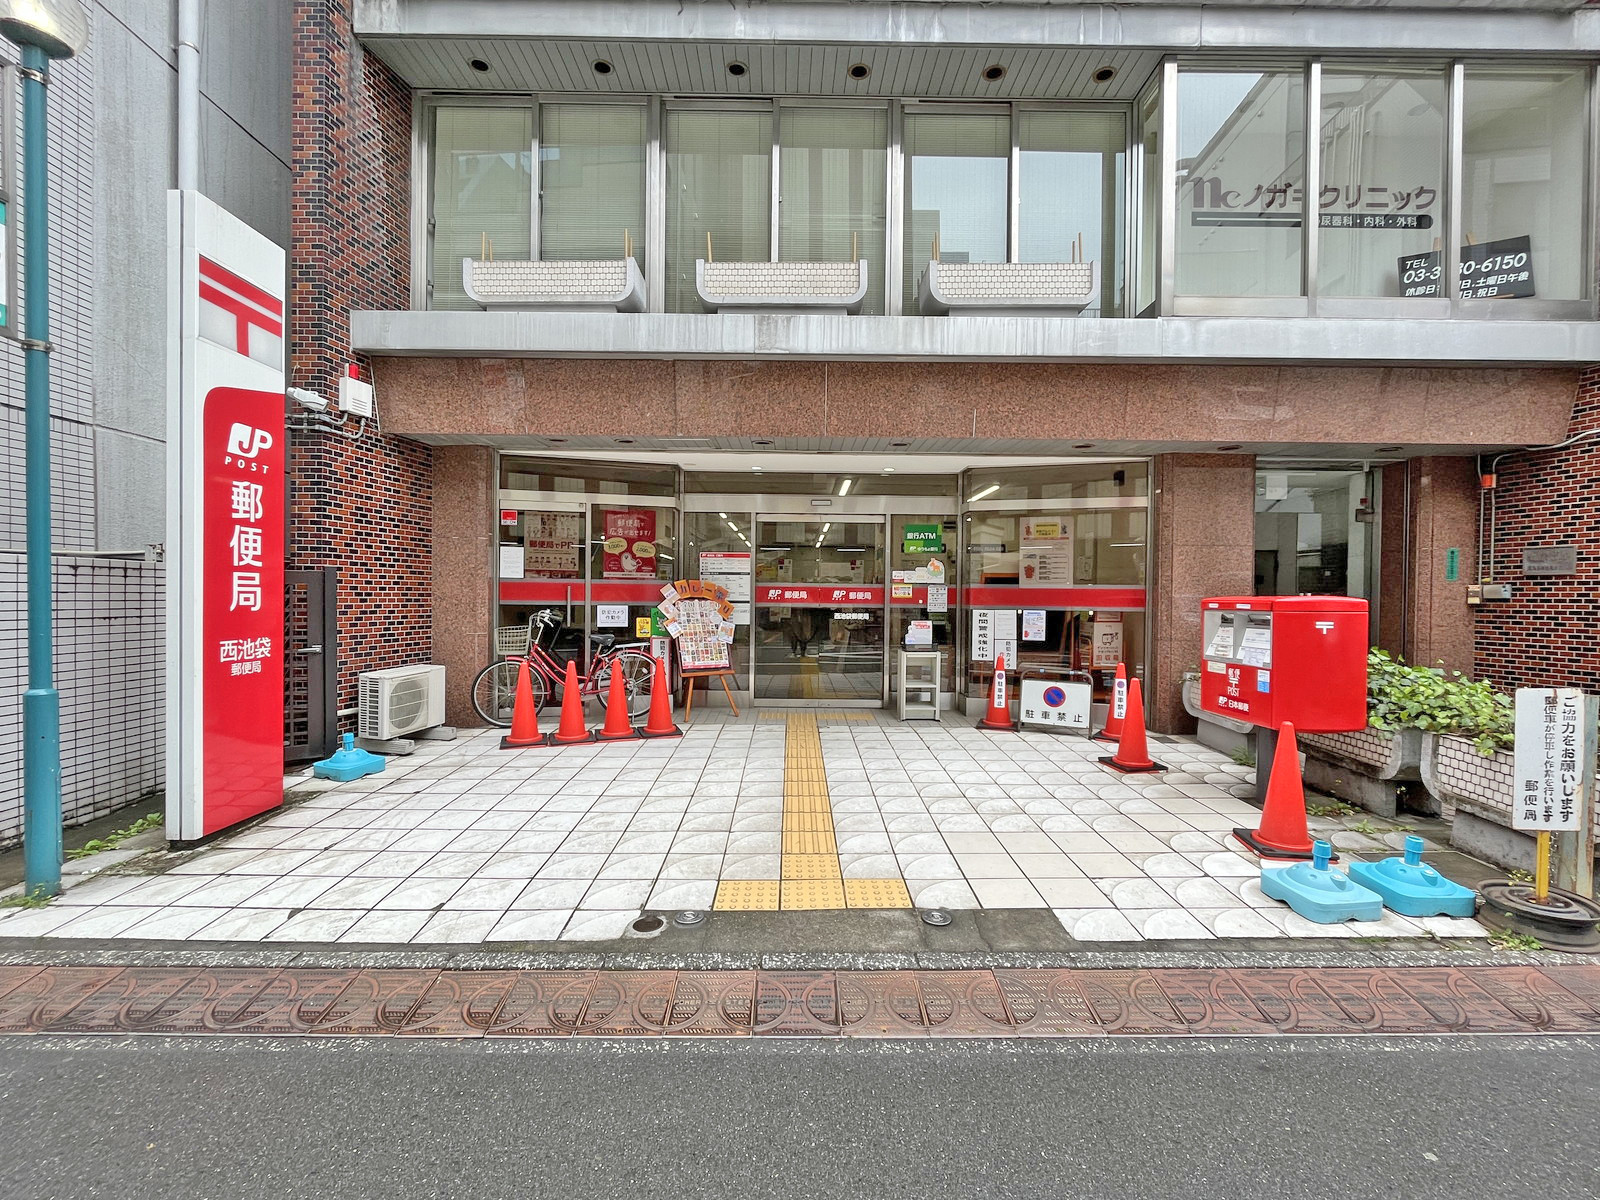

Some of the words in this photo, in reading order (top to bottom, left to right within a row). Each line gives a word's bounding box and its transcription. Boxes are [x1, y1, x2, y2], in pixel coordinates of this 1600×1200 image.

[1318, 215, 1418, 227] 尿器科・内科・外科
[1405, 259, 1429, 270] TEL
[224, 455, 270, 475] POST
[230, 480, 263, 612] 郵便局
[784, 590, 808, 599] 郵便局
[848, 591, 872, 600] 郵便局
[219, 637, 272, 663] 西池袋
[231, 659, 262, 676] 郵便局
[1228, 667, 1240, 679] 郵便
[1227, 687, 1240, 697] POST
[1228, 699, 1249, 712] 日本郵便
[1025, 709, 1083, 723] 駐車禁止
[1560, 696, 1577, 822] ご協力をお願いします
[1523, 780, 1539, 821] 郵便局
